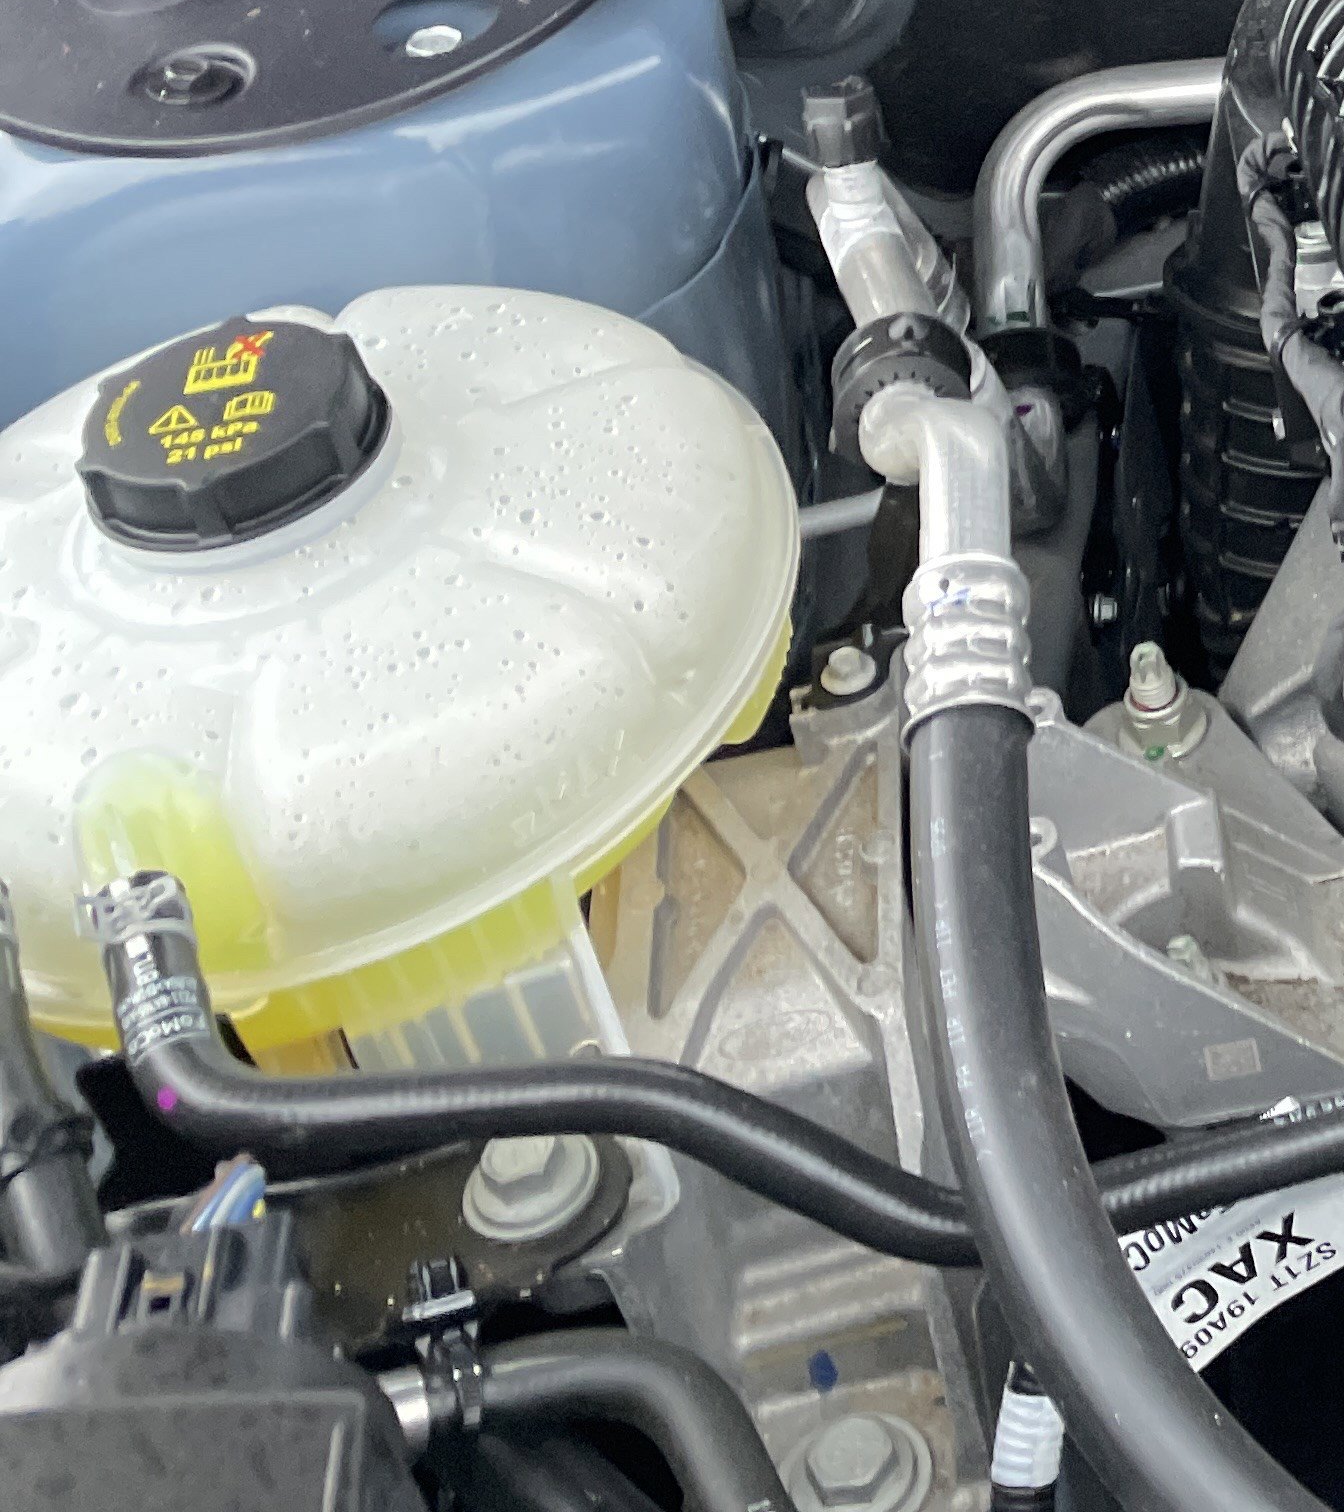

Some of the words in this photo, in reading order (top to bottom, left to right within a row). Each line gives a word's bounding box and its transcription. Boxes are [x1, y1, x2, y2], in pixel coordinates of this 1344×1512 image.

[210, 421, 260, 440] kPa
[166, 446, 197, 465] 21
[202, 438, 243, 460] psi
[1170, 1211, 1315, 1326] XAC
[1270, 1240, 1338, 1293] SZ1T
